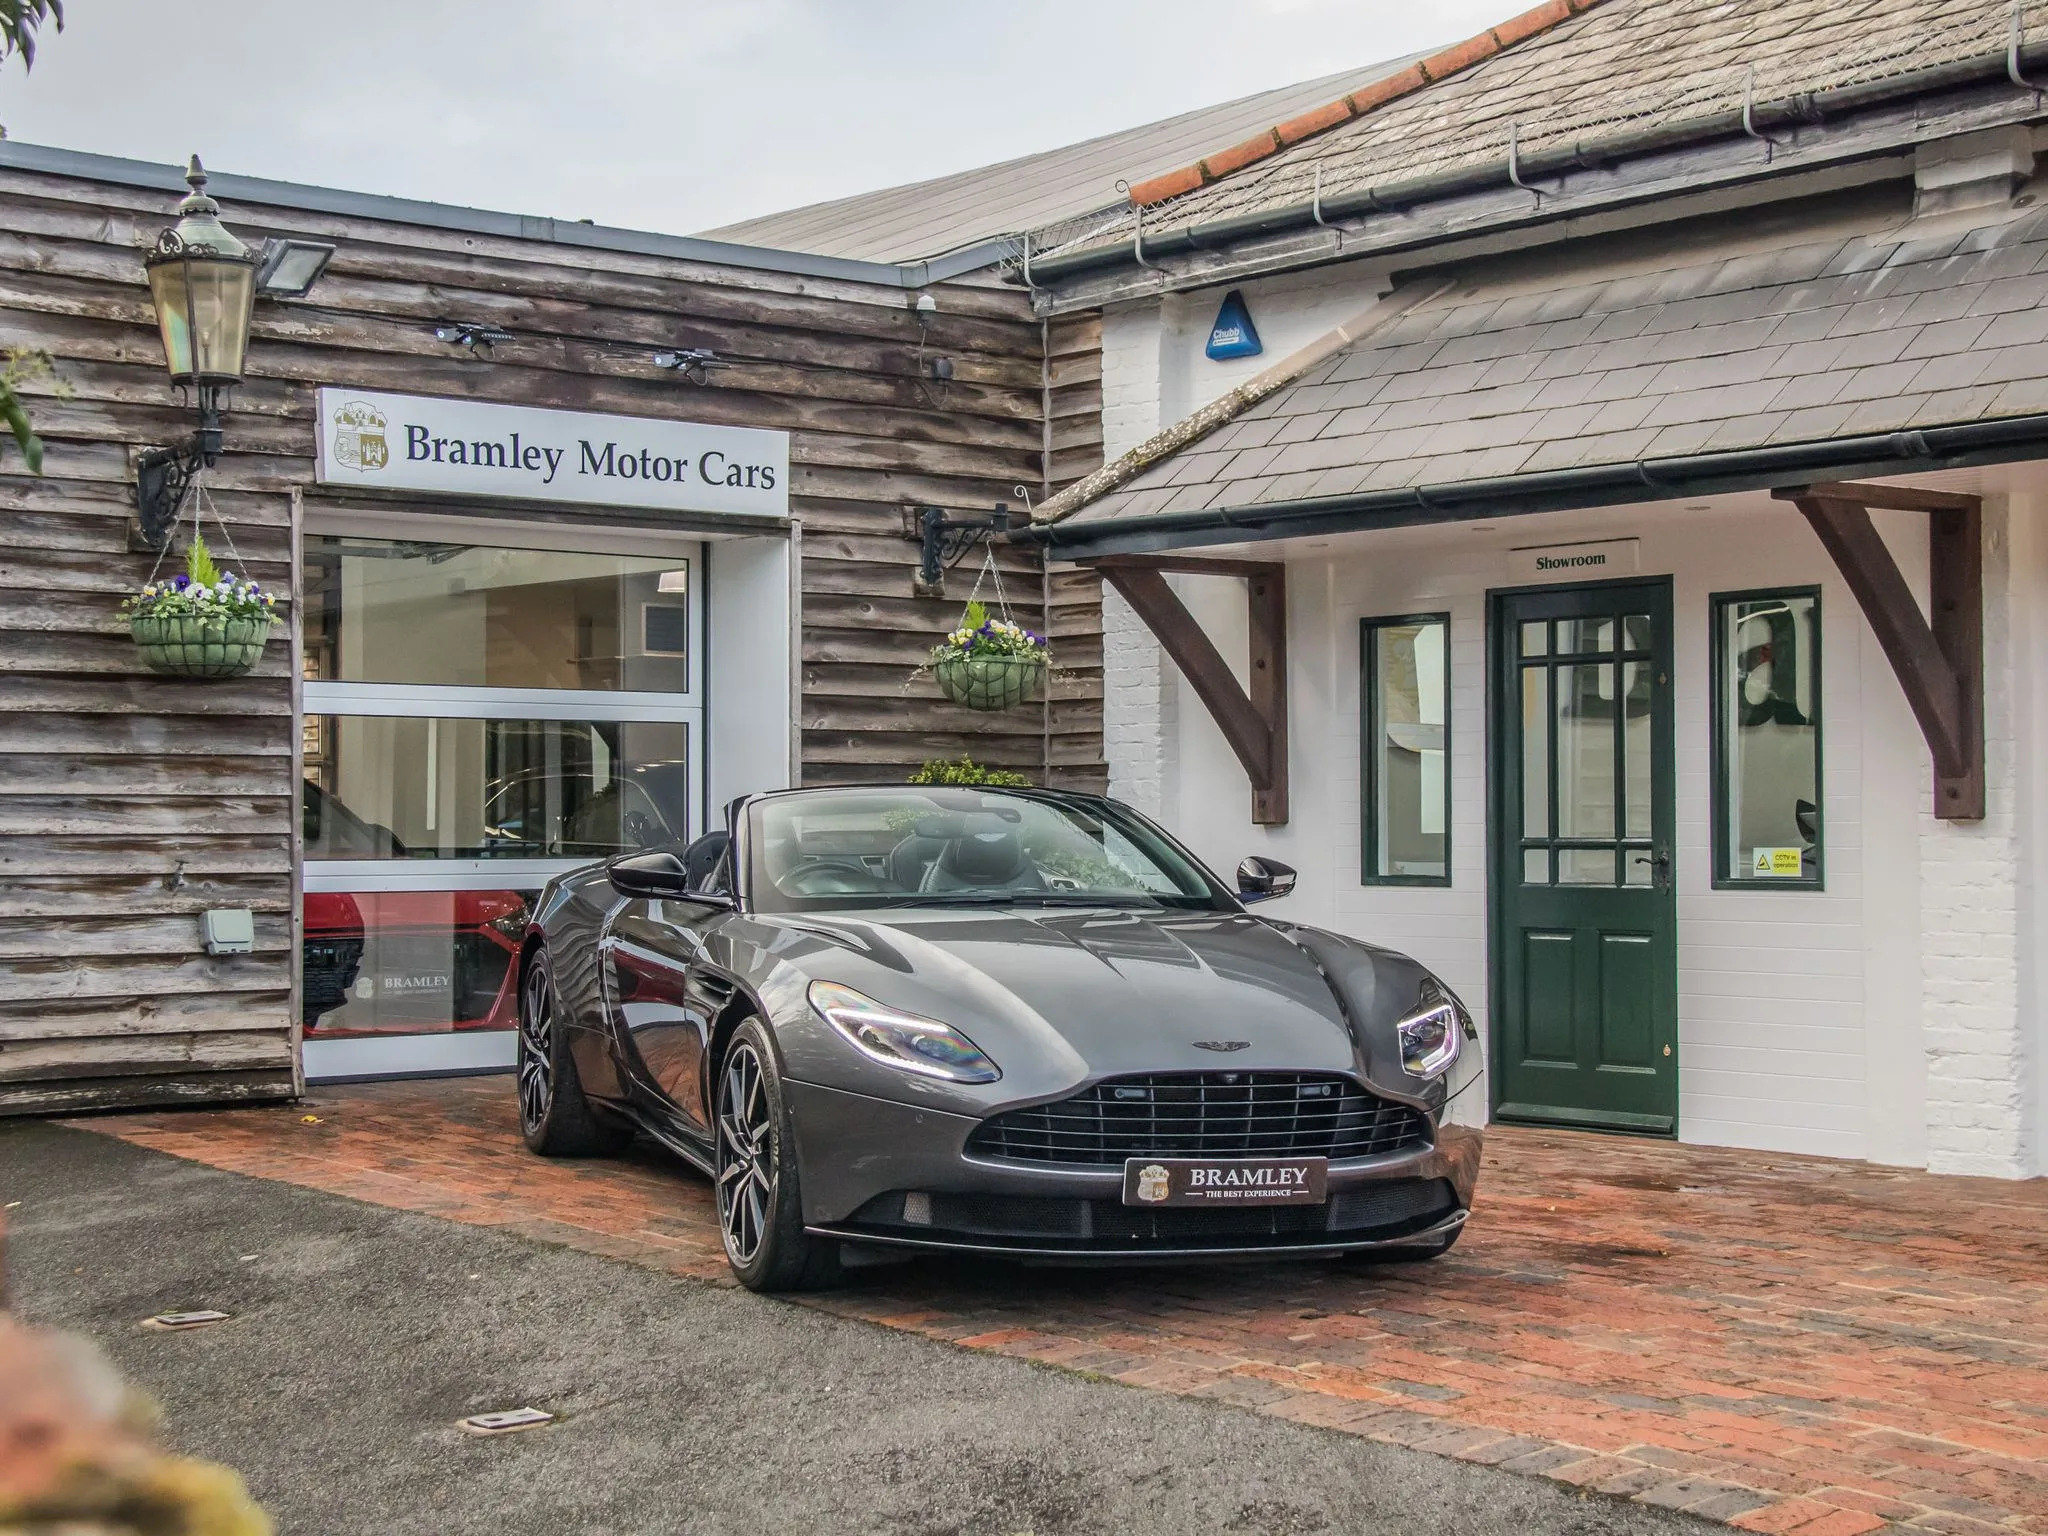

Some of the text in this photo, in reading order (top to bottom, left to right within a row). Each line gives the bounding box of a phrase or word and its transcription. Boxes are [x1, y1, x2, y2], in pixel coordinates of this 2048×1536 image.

[1213, 327, 1240, 339] Chubb
[404, 424, 776, 490] Bramley Motor Cars
[1536, 554, 1606, 570] Showroom
[385, 975, 450, 989] BRAMLEY
[1190, 1167, 1308, 1186] BRAMLEY
[1205, 1189, 1292, 1198] THE BEST EXPERIENCE
